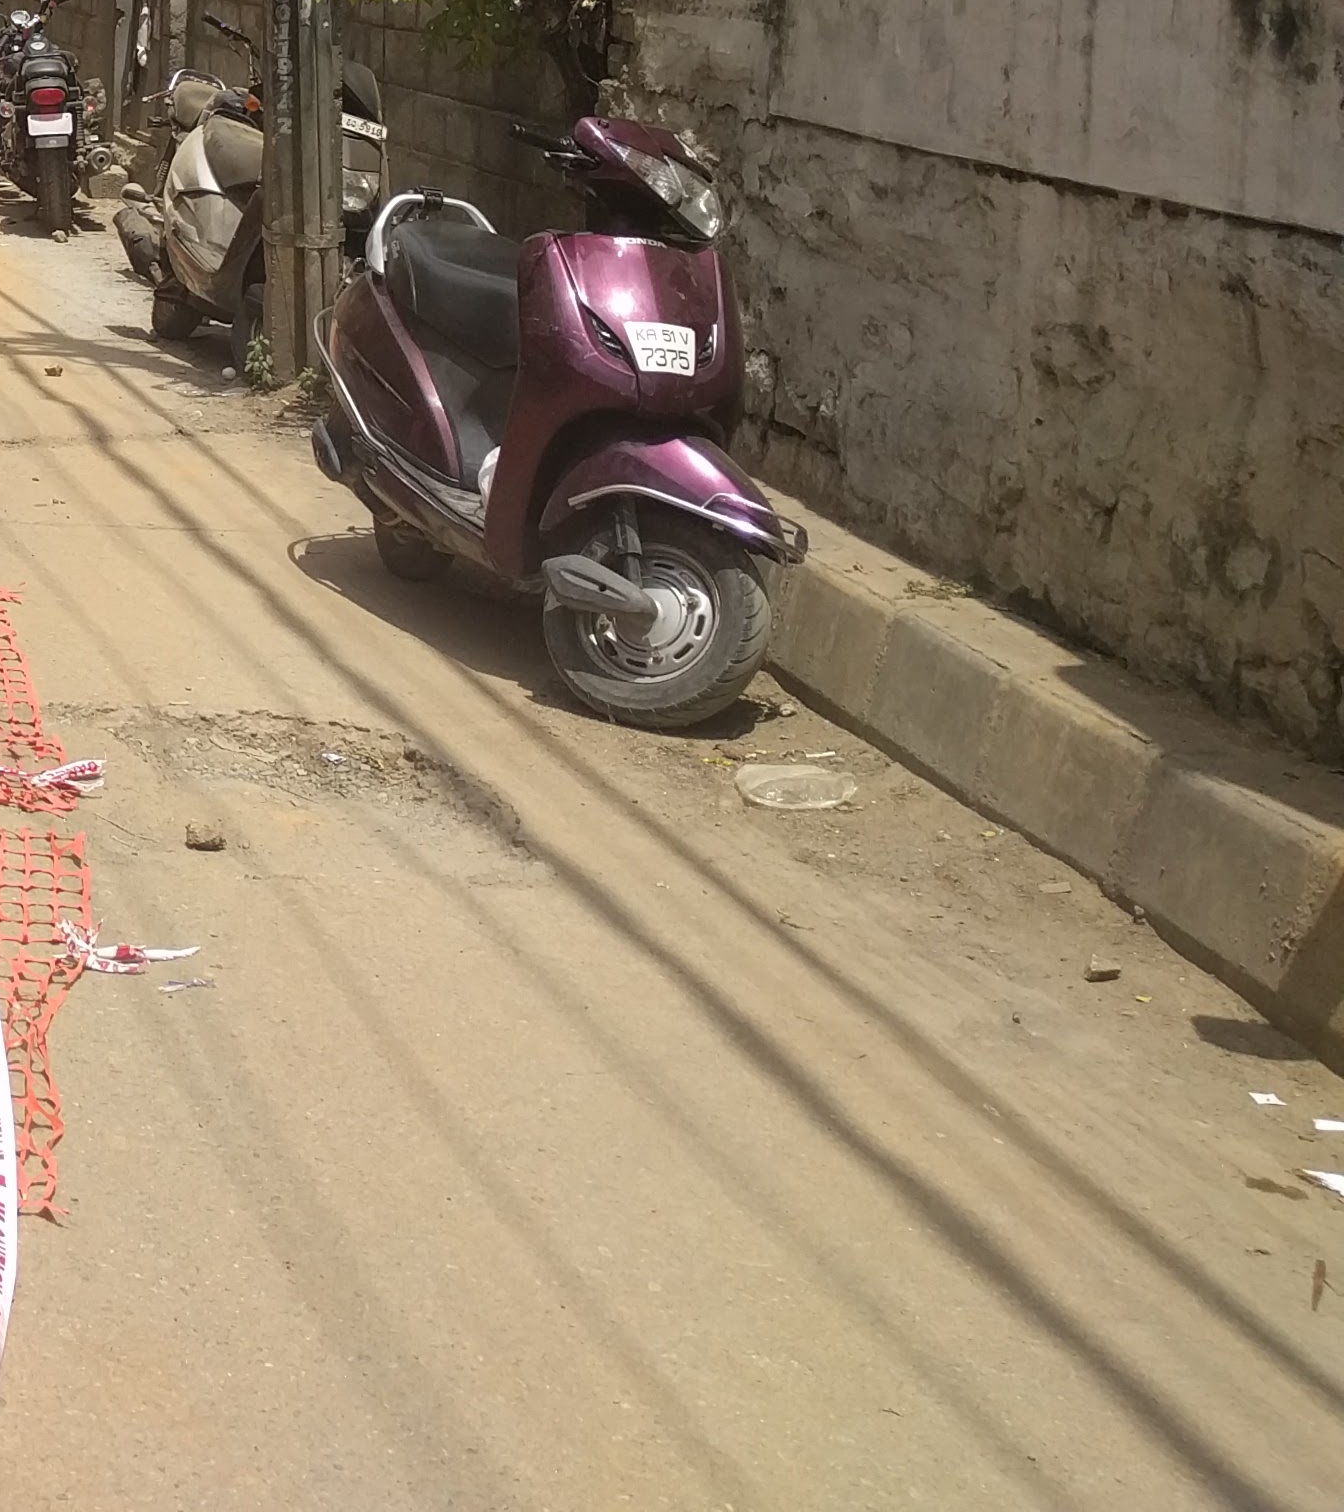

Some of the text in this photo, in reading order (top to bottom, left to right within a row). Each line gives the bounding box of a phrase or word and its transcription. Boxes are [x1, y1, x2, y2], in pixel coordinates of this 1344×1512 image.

[635, 329, 688, 345] KA 51 V
[641, 347, 690, 371] 7375
